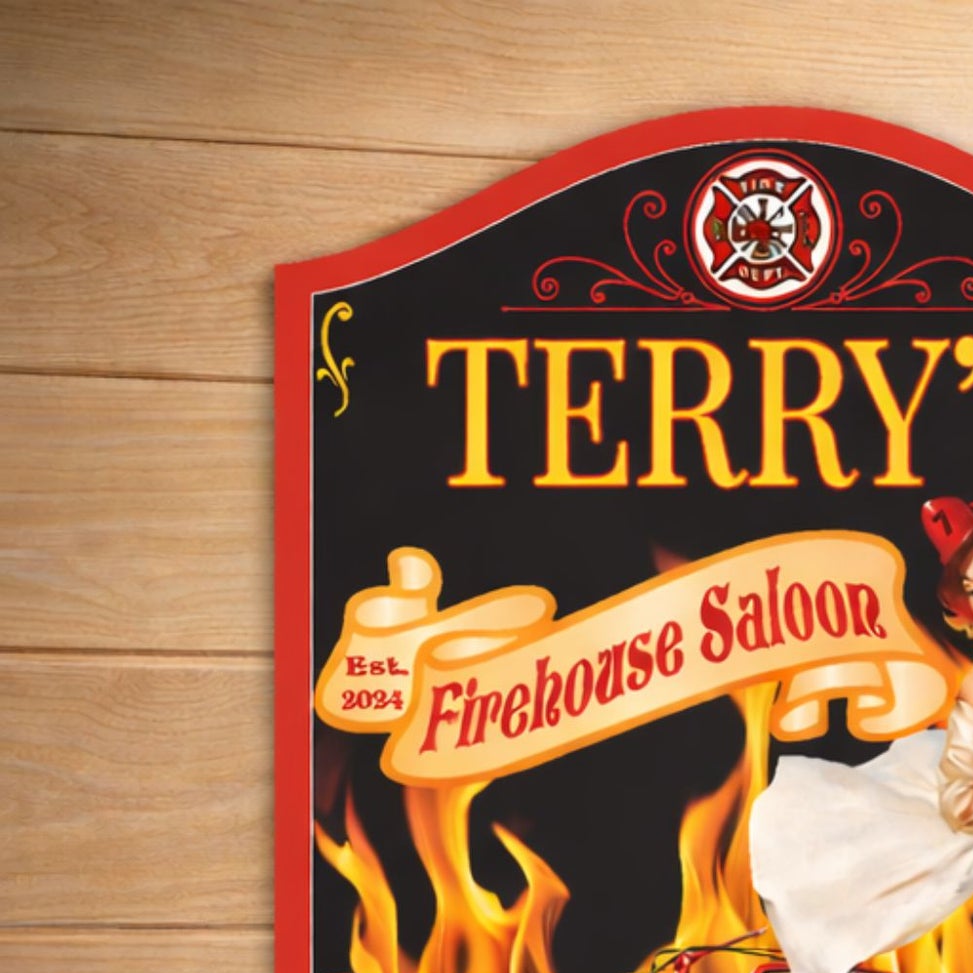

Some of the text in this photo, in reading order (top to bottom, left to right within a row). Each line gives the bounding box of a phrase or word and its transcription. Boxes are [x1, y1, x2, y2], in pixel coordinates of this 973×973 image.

[346, 655, 409, 676] Est.
[419, 565, 888, 755] Firehouse Saloon
[341, 689, 404, 711] 2024
